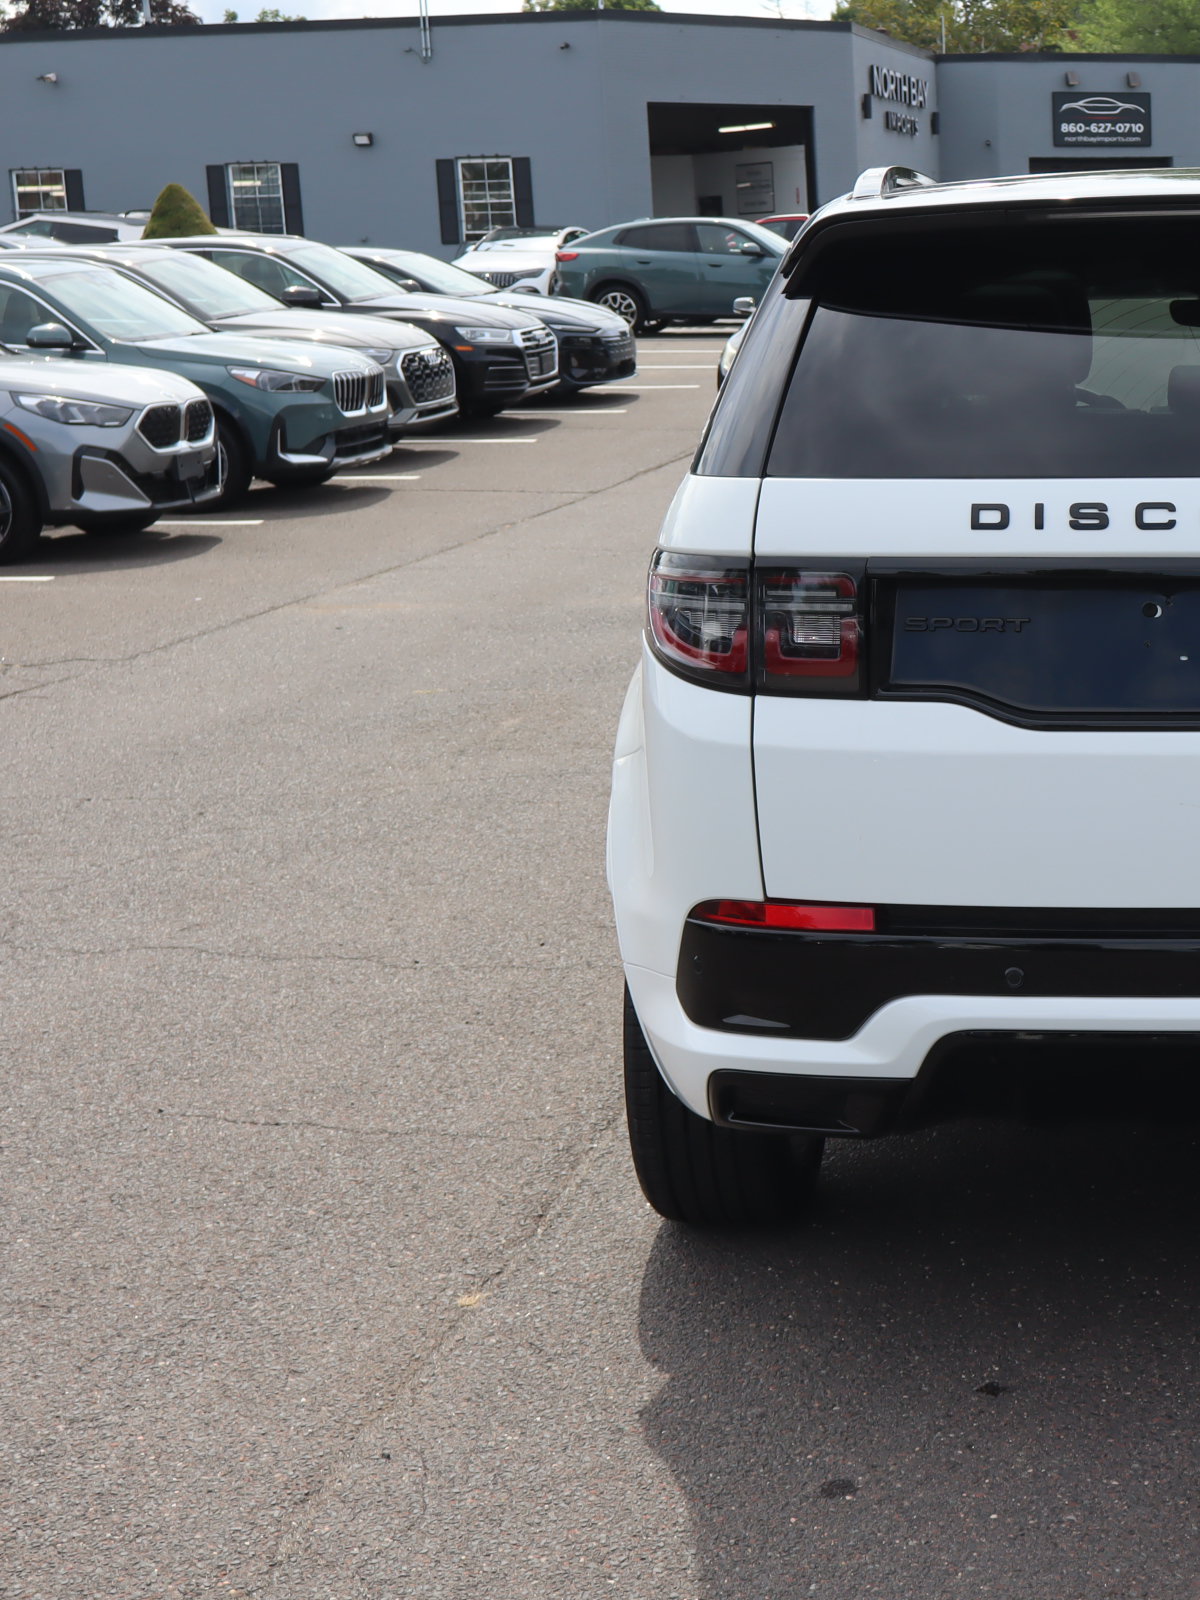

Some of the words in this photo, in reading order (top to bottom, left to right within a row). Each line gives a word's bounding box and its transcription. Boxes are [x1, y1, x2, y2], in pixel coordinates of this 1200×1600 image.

[870, 64, 909, 105] NORTH
[910, 76, 928, 108] BAY
[1061, 123, 1144, 133] 860-627-0710
[904, 617, 1031, 632] SPORT
